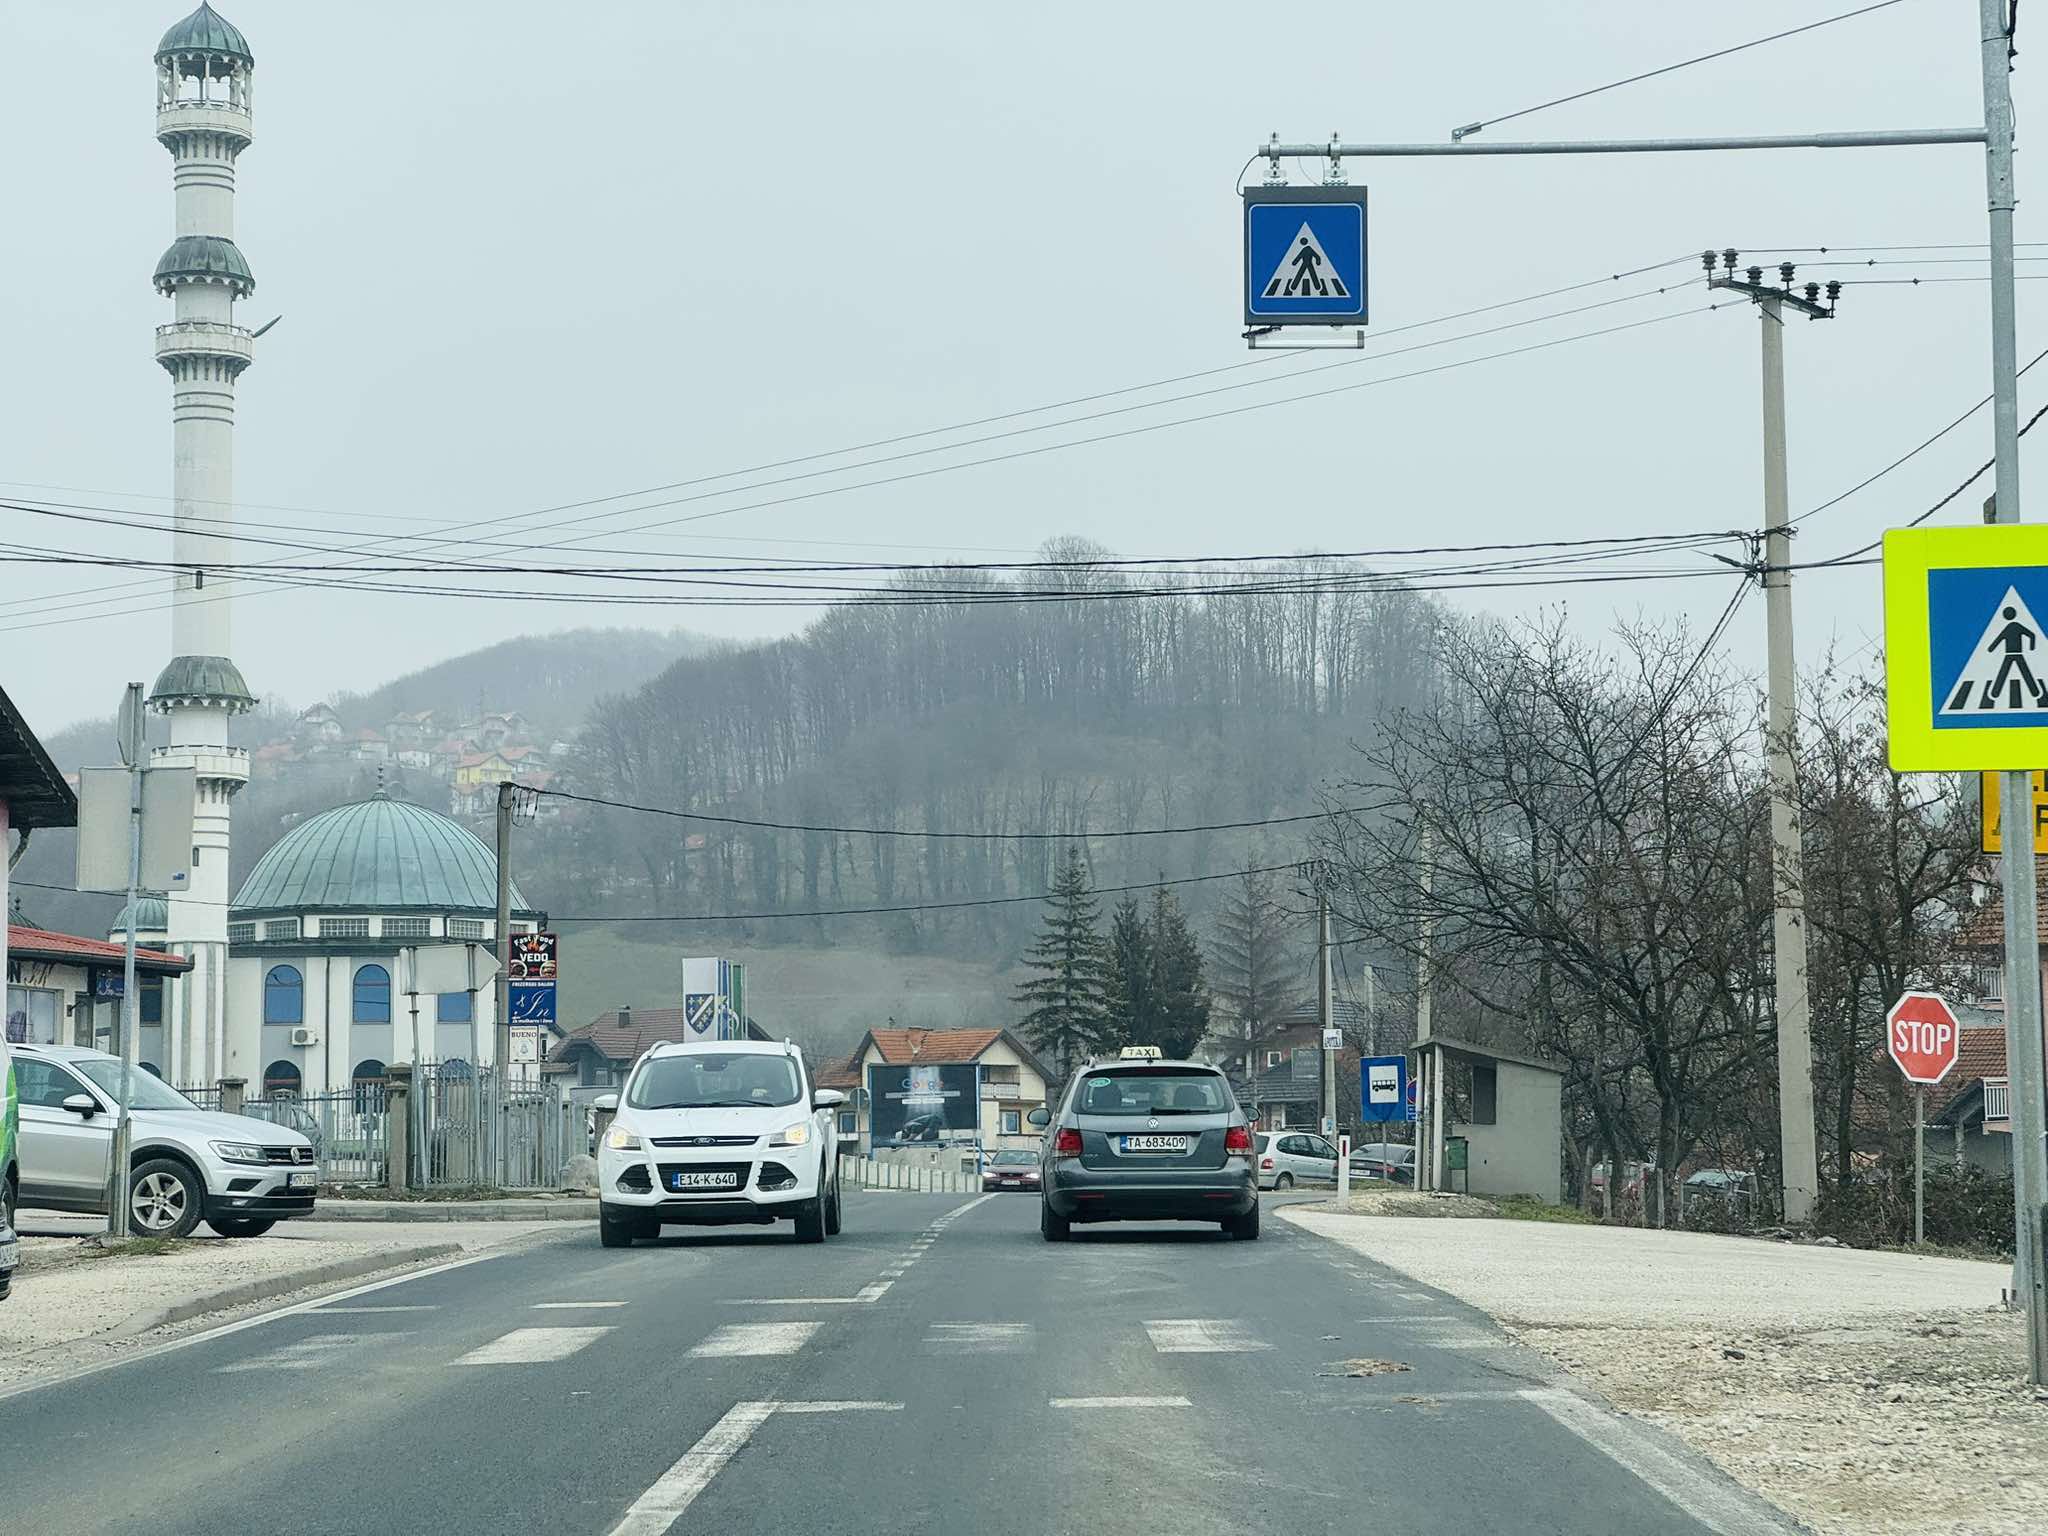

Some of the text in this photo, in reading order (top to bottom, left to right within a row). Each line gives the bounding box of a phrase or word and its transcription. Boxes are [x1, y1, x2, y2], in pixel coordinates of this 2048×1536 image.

[513, 934, 555, 947] Fast Food
[519, 953, 549, 962] VEDO
[1895, 1019, 1952, 1056] STOP
[1127, 1048, 1155, 1056] TAXI
[1127, 1136, 1186, 1148] TA-683409
[679, 1173, 736, 1186] E14-K-640
